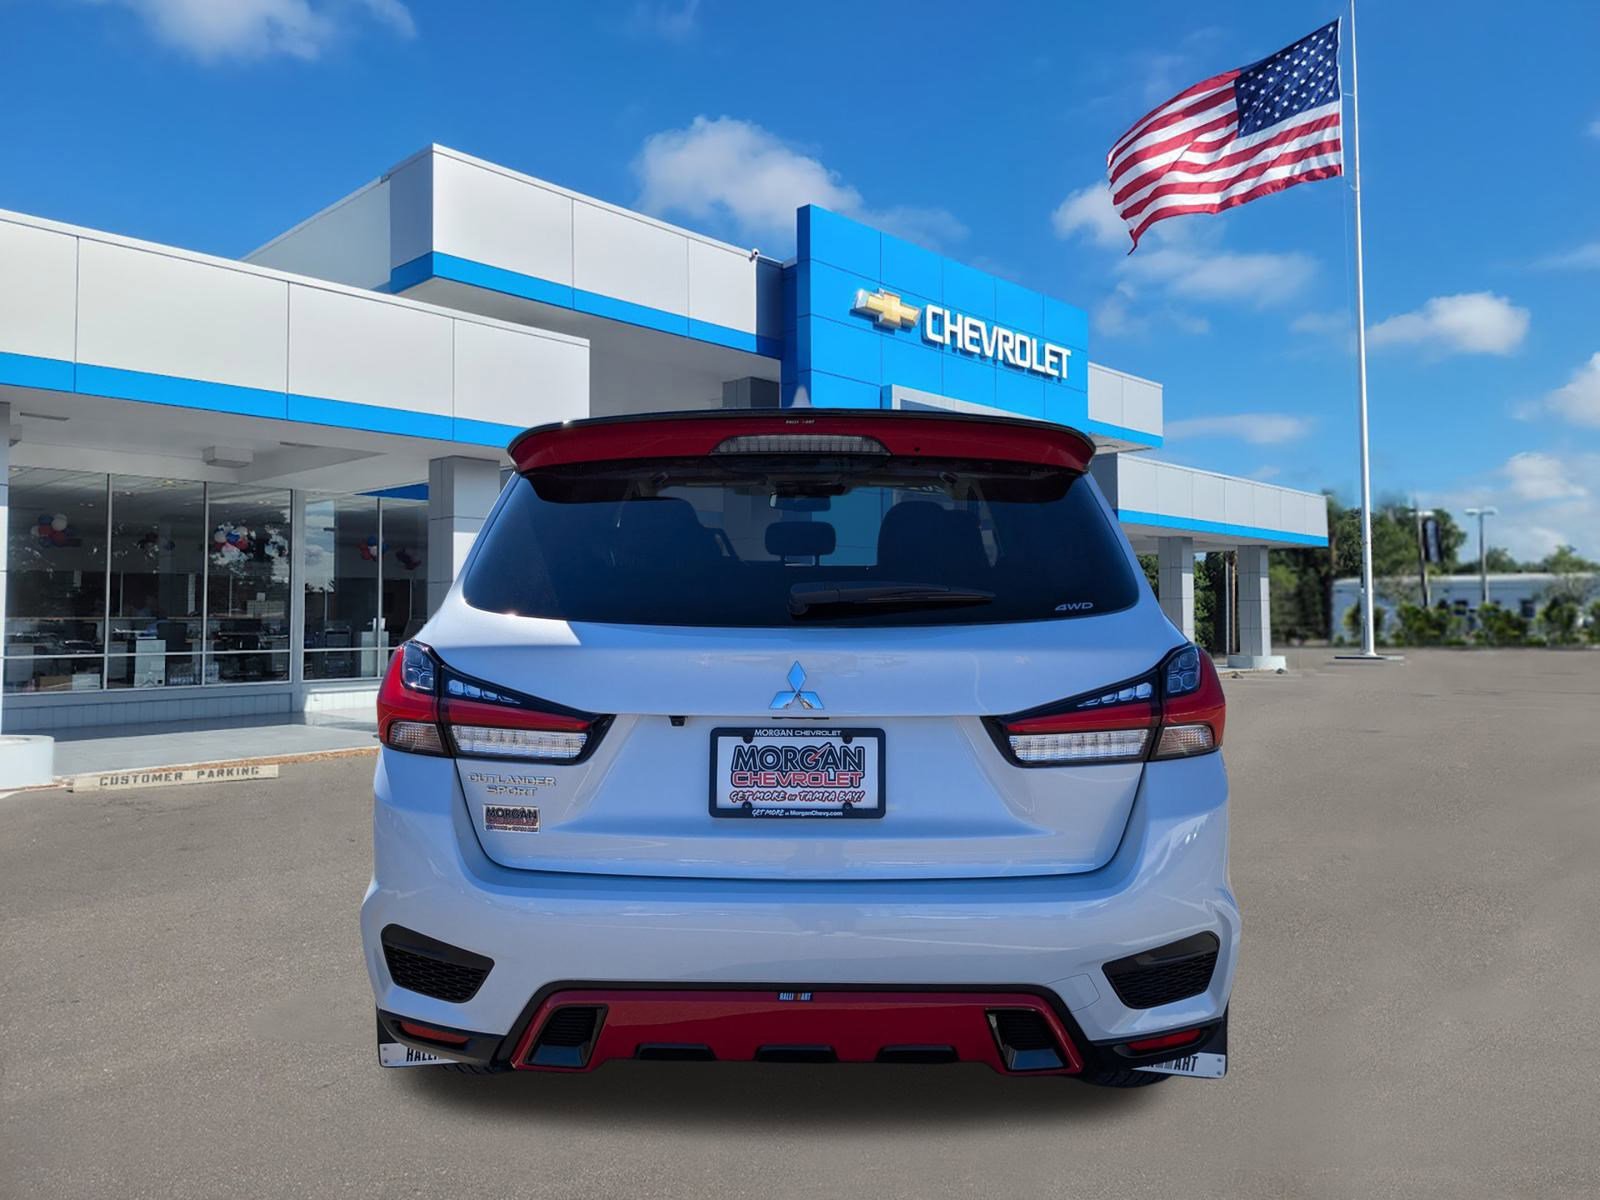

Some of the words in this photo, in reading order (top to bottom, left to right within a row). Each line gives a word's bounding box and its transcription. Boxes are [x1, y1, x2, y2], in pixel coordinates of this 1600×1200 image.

[923, 304, 1071, 379] CHEVROLET
[1055, 601, 1094, 611] 4WD
[732, 742, 865, 772] MORGAN
[99, 772, 184, 787] CUSTOMER
[197, 766, 260, 780] PARKING
[468, 772, 557, 786] OUTLANDER
[731, 771, 865, 787] CHEVROLET
[487, 785, 538, 796] SPORT
[730, 790, 752, 802] GET
[754, 790, 786, 801] MORE
[799, 790, 836, 801] TAMPA
[837, 790, 865, 801] BAY!
[486, 806, 537, 819] MORGAN
[752, 809, 766, 817] GET
[766, 808, 785, 816] MORE
[790, 809, 843, 817] MorganChevy.com
